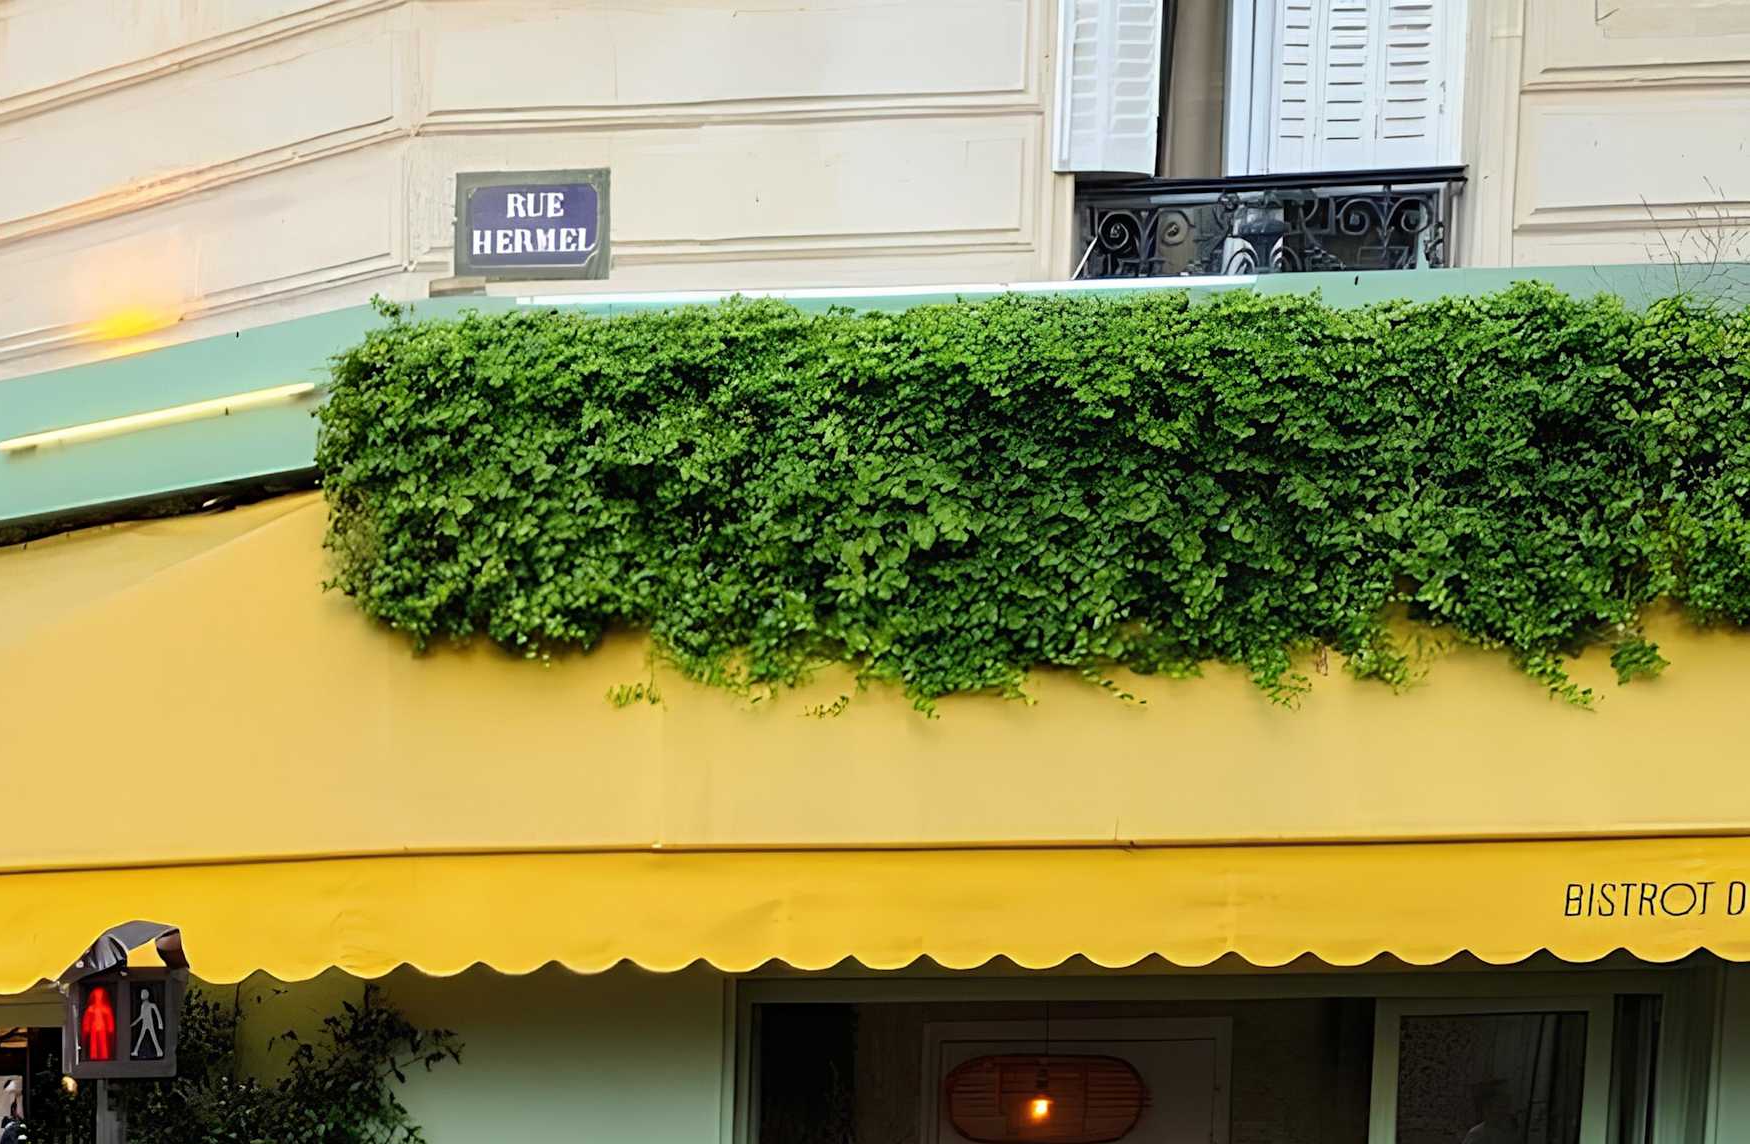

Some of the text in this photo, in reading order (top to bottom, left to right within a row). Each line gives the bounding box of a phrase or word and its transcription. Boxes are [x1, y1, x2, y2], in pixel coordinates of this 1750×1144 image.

[506, 192, 564, 218] RUE
[472, 228, 596, 255] HERMEL
[1564, 882, 1716, 917] BISTROT
